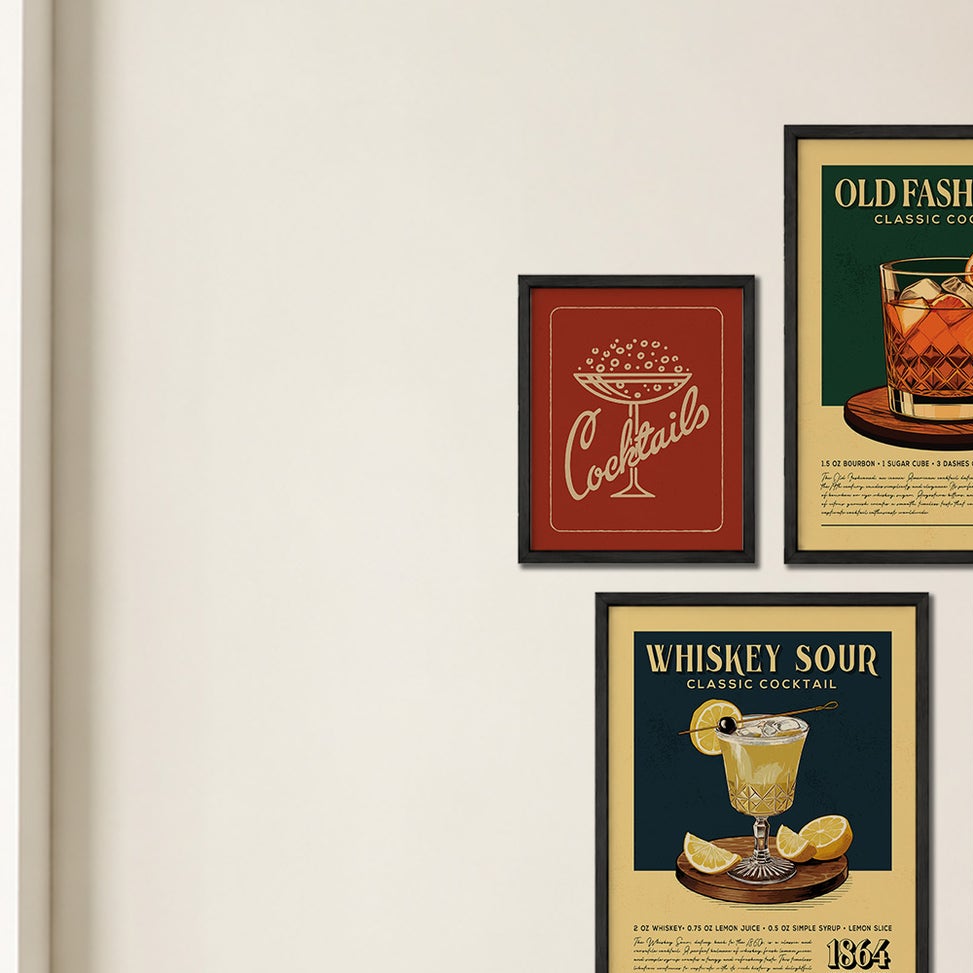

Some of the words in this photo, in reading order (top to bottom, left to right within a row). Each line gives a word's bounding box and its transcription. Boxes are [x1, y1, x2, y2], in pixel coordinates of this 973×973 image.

[835, 178, 896, 208] OLD
[874, 214, 940, 225] CLASSIC
[564, 385, 710, 501] Cocktails
[831, 459, 842, 468] OZ
[843, 459, 876, 468] BOURBON
[887, 459, 911, 468] SUGAR
[911, 459, 930, 468] CUBE
[942, 459, 970, 468] DASHES
[646, 644, 781, 676] WHISKEY
[795, 644, 879, 676] SOUR
[686, 679, 753, 690] CLASSIC
[759, 679, 837, 690] COCKTAIL
[633, 924, 639, 932] 2
[640, 924, 650, 932] OZ
[686, 924, 702, 932] 0.75
[703, 924, 713, 932] OZ
[715, 924, 739, 932] LEMON
[740, 924, 761, 932] JUICE
[767, 924, 779, 932] 0.5
[780, 924, 790, 932] OZ
[792, 924, 816, 932] SIMPLE
[818, 924, 841, 932] SYRUP
[848, 924, 872, 932] LEMON
[873, 924, 893, 932] SLICE
[826, 938, 893, 971] 1864
